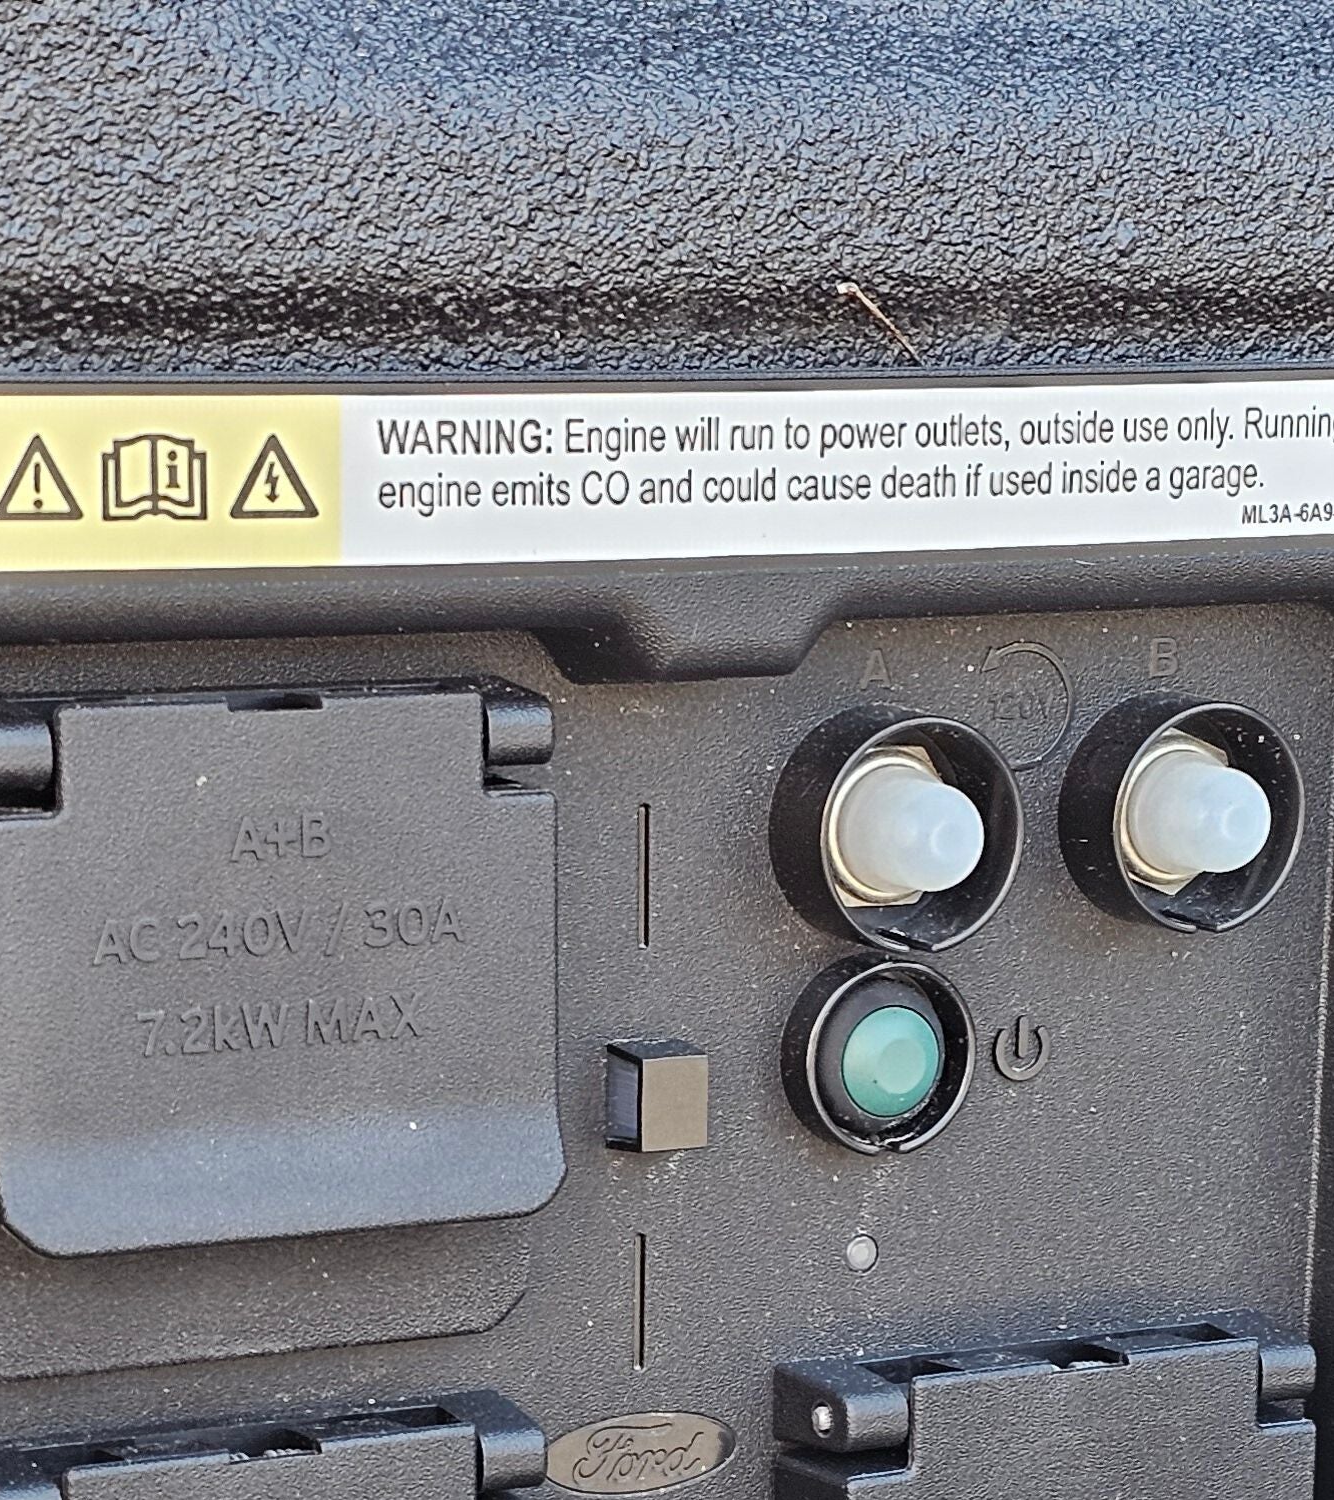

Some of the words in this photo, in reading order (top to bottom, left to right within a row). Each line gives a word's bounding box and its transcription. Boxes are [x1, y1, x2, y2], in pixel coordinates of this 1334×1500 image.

[377, 419, 553, 456] WARNING:
[566, 418, 665, 461] Engine
[676, 416, 719, 451] will
[730, 425, 773, 450] run
[784, 417, 810, 449] to
[820, 422, 906, 457] power
[916, 411, 1010, 449] outlets,
[1021, 408, 1114, 445] outside
[1124, 416, 1168, 443] use
[1177, 407, 1234, 446] only.
[379, 472, 481, 516] engine
[493, 471, 570, 506] emits
[581, 469, 630, 504] CO
[639, 469, 692, 504] and
[703, 467, 775, 503] could
[787, 474, 871, 500] cause
[881, 464, 956, 498] death
[964, 463, 983, 497] if
[988, 462, 1053, 497] used
[1061, 460, 1139, 493] inside
[1145, 467, 1161, 491] a
[1169, 462, 1266, 498] garage.
[860, 648, 895, 690] A
[1148, 636, 1181, 679] B
[231, 813, 333, 863] A+B
[93, 916, 161, 965] AC
[177, 905, 312, 961] 240V
[325, 902, 349, 957] /
[364, 899, 465, 948] 30A
[137, 998, 290, 1058] 7.2kW
[305, 991, 424, 1046] MAX
[572, 1423, 704, 1485] Ford
